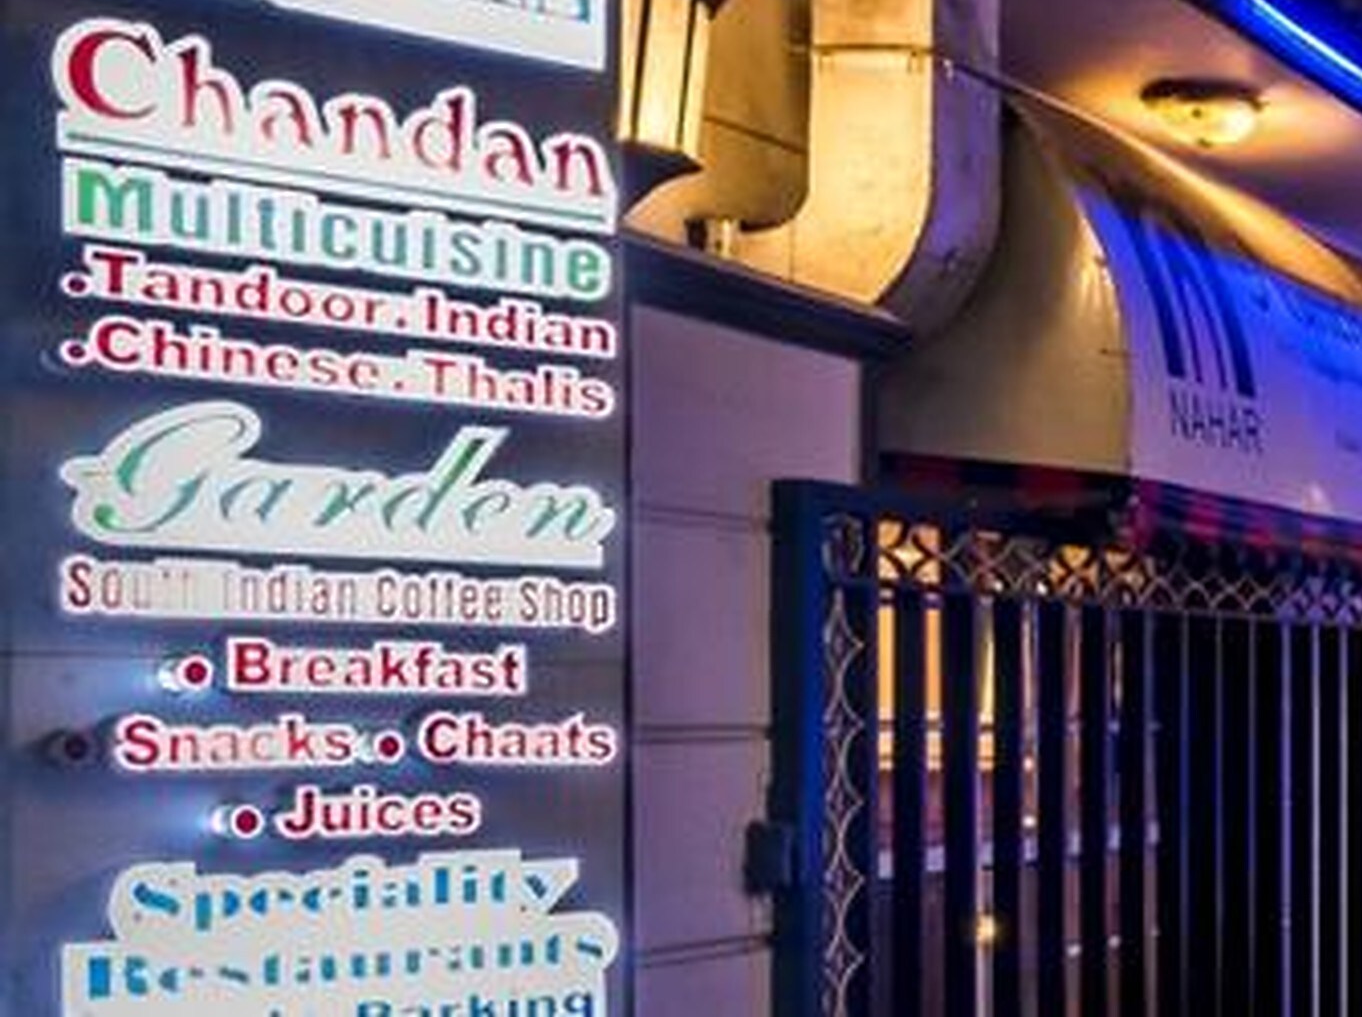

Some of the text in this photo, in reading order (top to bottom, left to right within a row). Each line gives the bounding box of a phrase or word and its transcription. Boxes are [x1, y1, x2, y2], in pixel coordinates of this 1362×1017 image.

[67, 29, 604, 197] Chandan
[74, 167, 602, 293] Multicuisine
[422, 356, 612, 416] Thalis
[1169, 389, 1264, 454] NAHAR
[74, 413, 607, 541] Garden
[221, 568, 360, 617] Indian
[376, 573, 504, 620] Coffee
[519, 581, 611, 628] Shop
[233, 642, 523, 691] Breakfast
[121, 717, 614, 767] Snacks Chaats
[281, 789, 478, 835] Juices
[132, 865, 552, 932] Speciality
[87, 932, 605, 1000] Restaurants
